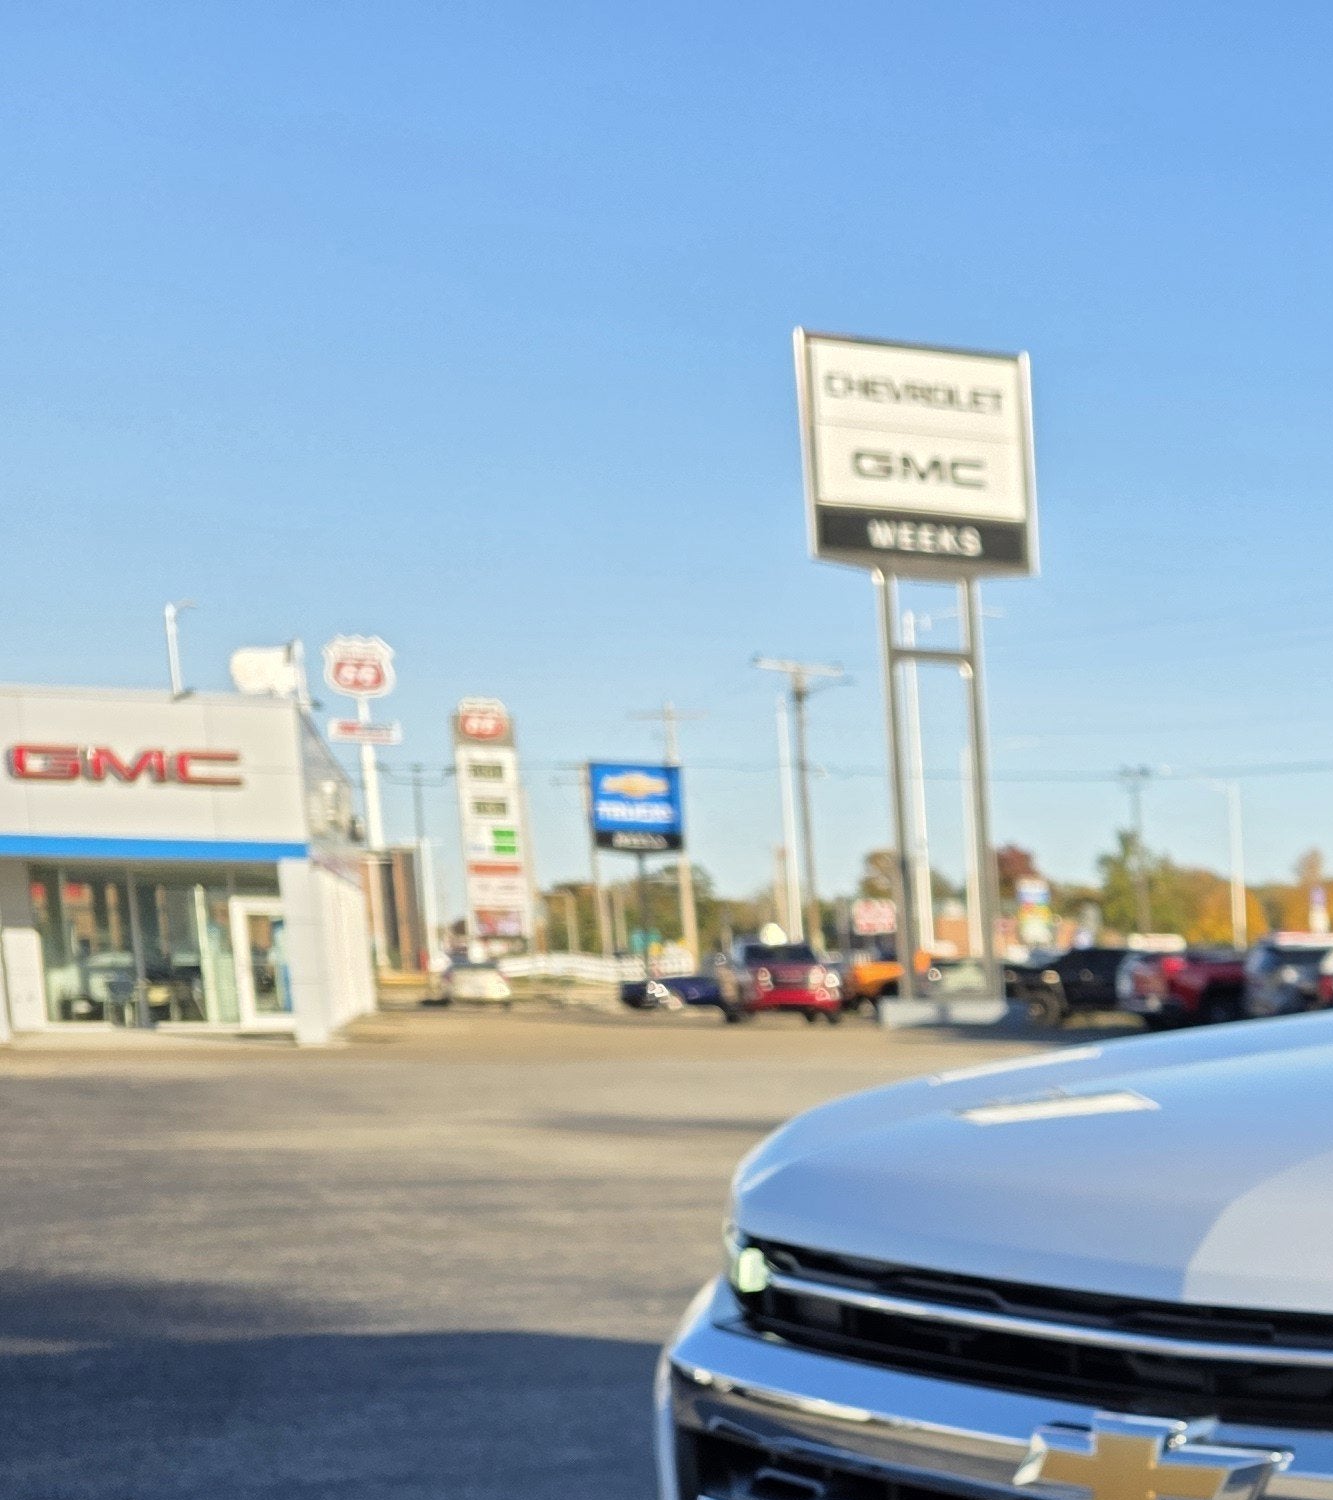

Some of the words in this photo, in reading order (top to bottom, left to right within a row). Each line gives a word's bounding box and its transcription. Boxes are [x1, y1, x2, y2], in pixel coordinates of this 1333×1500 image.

[824, 372, 1003, 413] CHEVROLET
[853, 451, 986, 488] GMC
[867, 519, 983, 557] WEEKS
[9, 744, 243, 786] GMC
